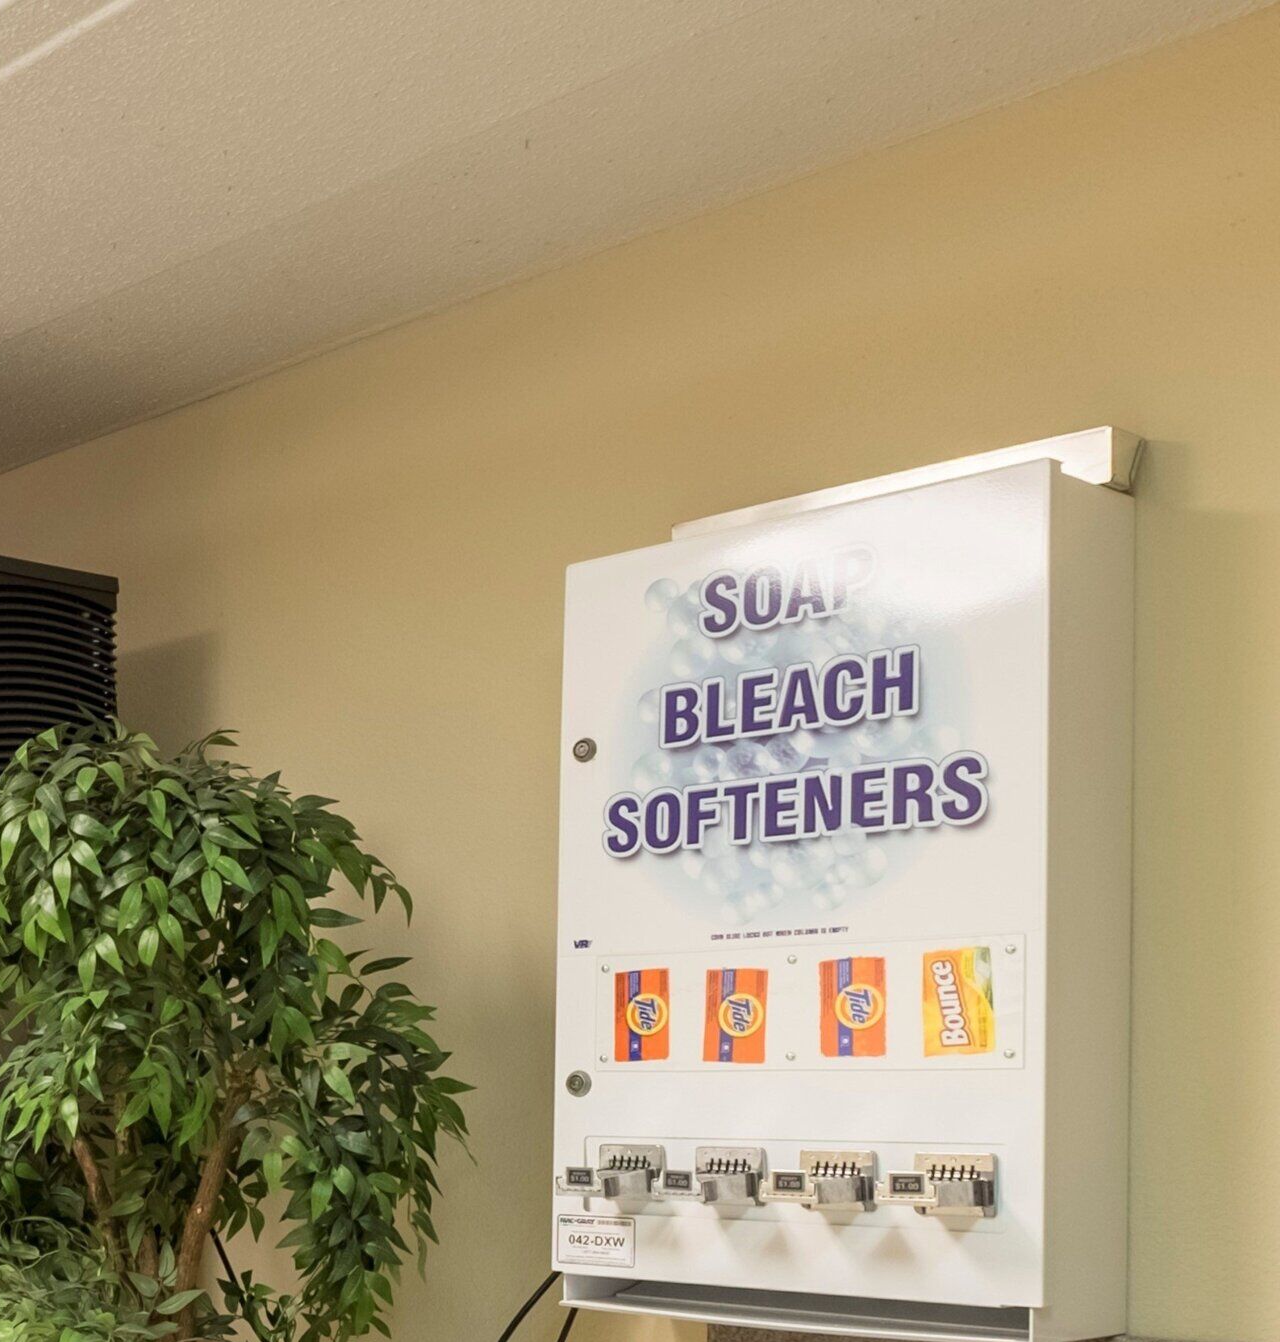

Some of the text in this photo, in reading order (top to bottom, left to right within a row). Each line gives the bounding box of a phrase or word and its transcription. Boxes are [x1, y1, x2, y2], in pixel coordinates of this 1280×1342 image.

[702, 551, 874, 634] SOAP
[663, 648, 917, 747] BLEACH
[605, 755, 984, 855] SOFTENERS
[635, 998, 658, 1031] Tide
[728, 998, 752, 1032] Tide
[844, 989, 872, 1024] Tide
[931, 959, 972, 1047] Bounce
[568, 1234, 626, 1248] 042-DXW
